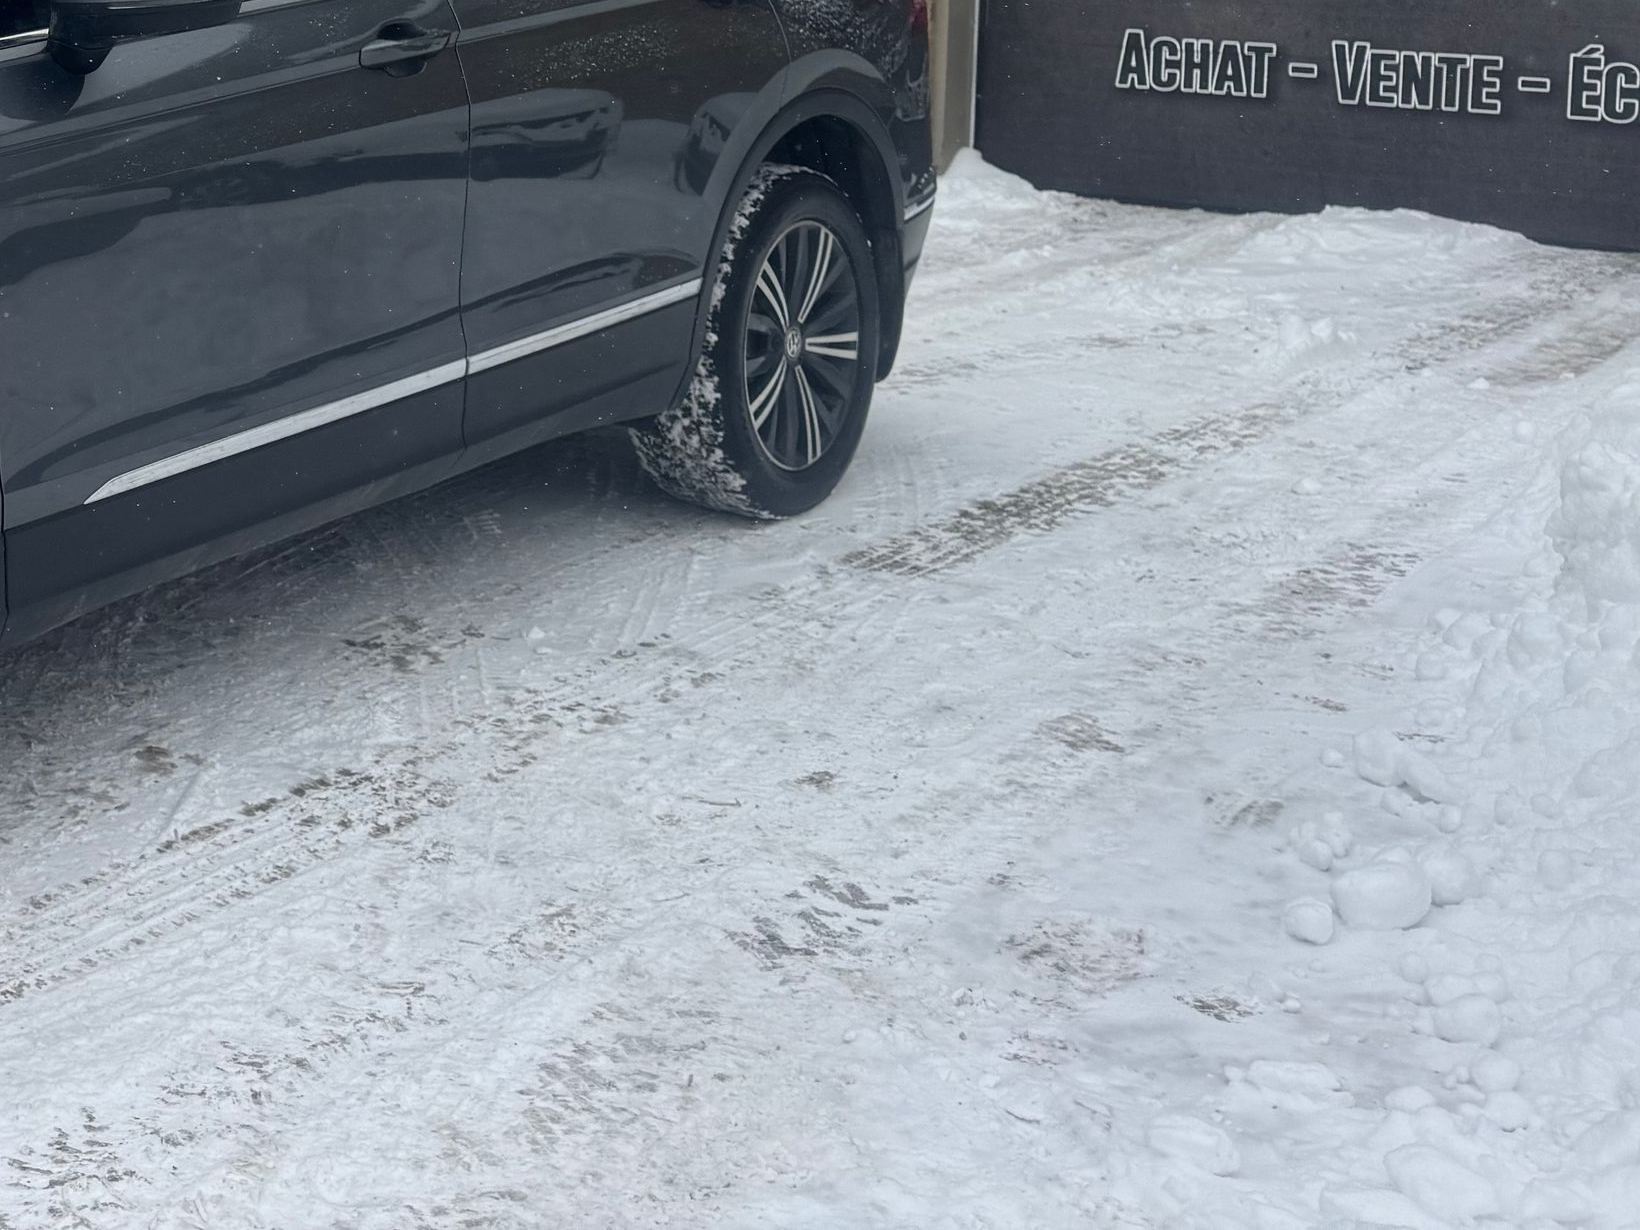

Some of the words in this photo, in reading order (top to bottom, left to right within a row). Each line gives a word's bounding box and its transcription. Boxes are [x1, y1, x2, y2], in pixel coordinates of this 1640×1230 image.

[1115, 29, 1276, 98] ACHAT
[1331, 40, 1502, 114] VENTE
[1567, 44, 1640, 123] ÉC
